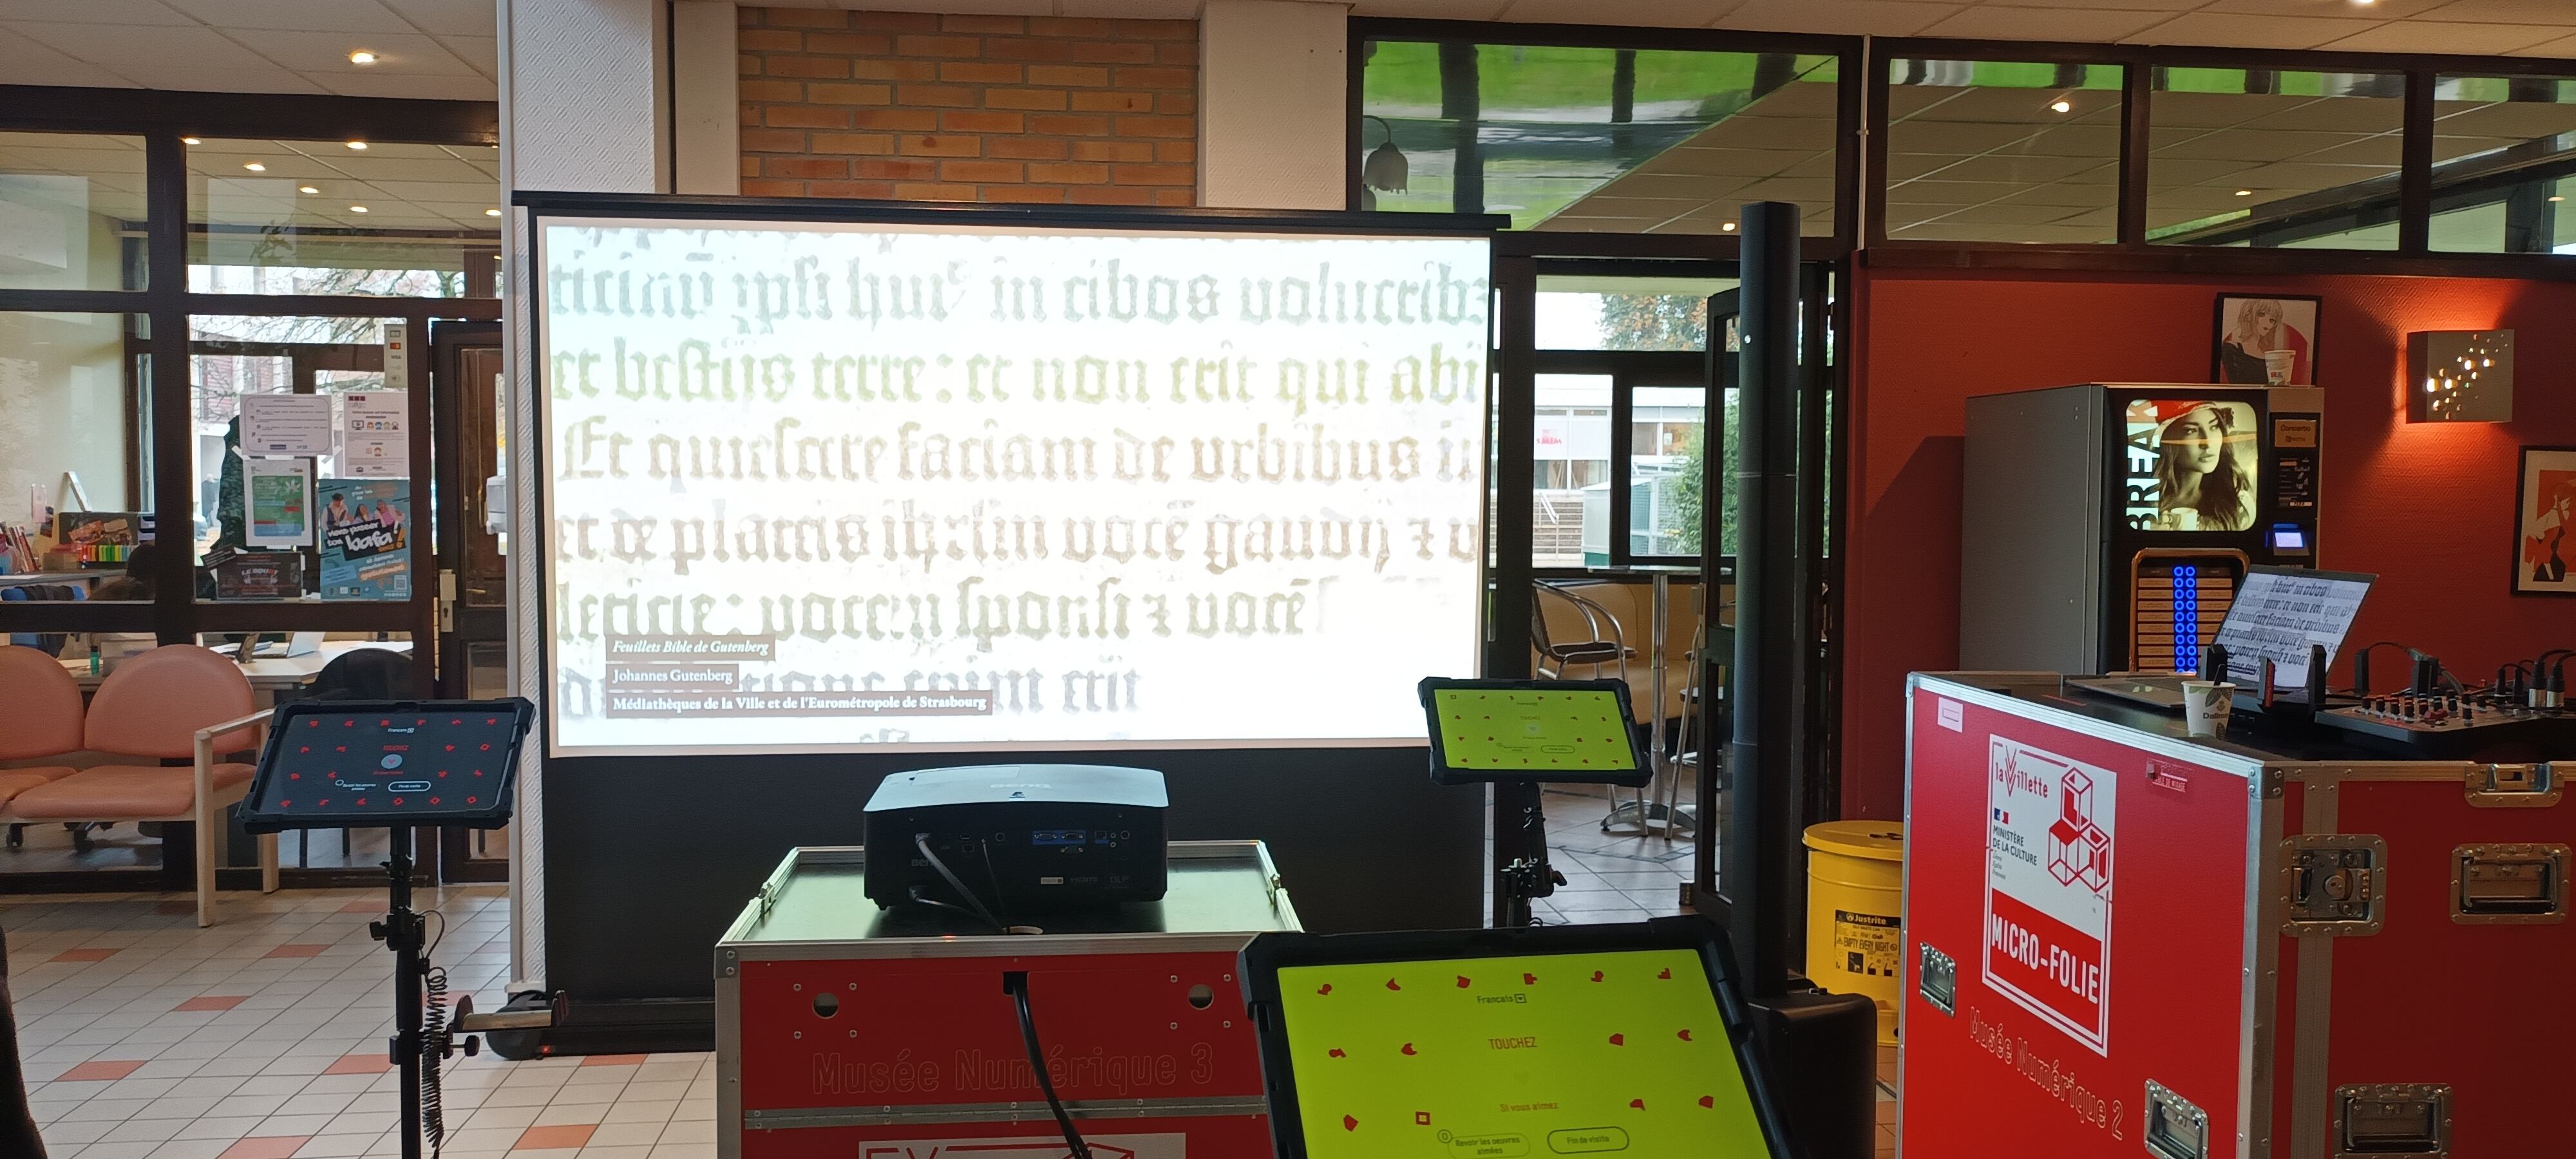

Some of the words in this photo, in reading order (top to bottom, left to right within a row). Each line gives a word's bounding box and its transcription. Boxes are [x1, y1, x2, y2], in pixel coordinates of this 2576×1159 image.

[612, 640, 661, 653] Feuillets
[663, 640, 692, 652] Bible
[694, 640, 708, 653] de
[710, 641, 769, 656] Gutenberg
[612, 668, 668, 684] Johannes
[670, 669, 734, 684] Gutenberg
[612, 697, 701, 713] Médiathèques
[704, 697, 719, 710] de
[721, 697, 733, 710] la
[735, 696, 765, 710] Ville
[767, 698, 780, 710] et
[782, 696, 798, 709] de
[800, 695, 900, 712] l'Eurométropole
[902, 695, 917, 708] de
[920, 695, 987, 712] Strasbourg
[2004, 746, 2049, 798] Villette
[1993, 825, 2024, 847] MINISTÈRE
[1993, 838, 2000, 849] DE
[2002, 841, 2009, 852] LA
[2010, 845, 2037, 866] CULTURE
[1855, 914, 1886, 925] Justrite
[1991, 913, 2099, 1004] MICRO-FOLIE
[1477, 995, 1514, 1004] Français
[1488, 1037, 1538, 1050] TOUCHEZ
[813, 1049, 940, 1096] Musée
[954, 1044, 1177, 1096] Numérique
[1191, 1042, 1213, 1084] 3
[1969, 1005, 2012, 1065] Musée
[2017, 1037, 2107, 1129] Numérique
[2112, 1099, 2123, 1141] 2
[1500, 1104, 1509, 1113] Si
[1533, 1102, 1559, 1111] aimez
[1455, 1138, 1478, 1147] Revoir
[1479, 1138, 1491, 1146] les
[1589, 1135, 1610, 1144] visite
